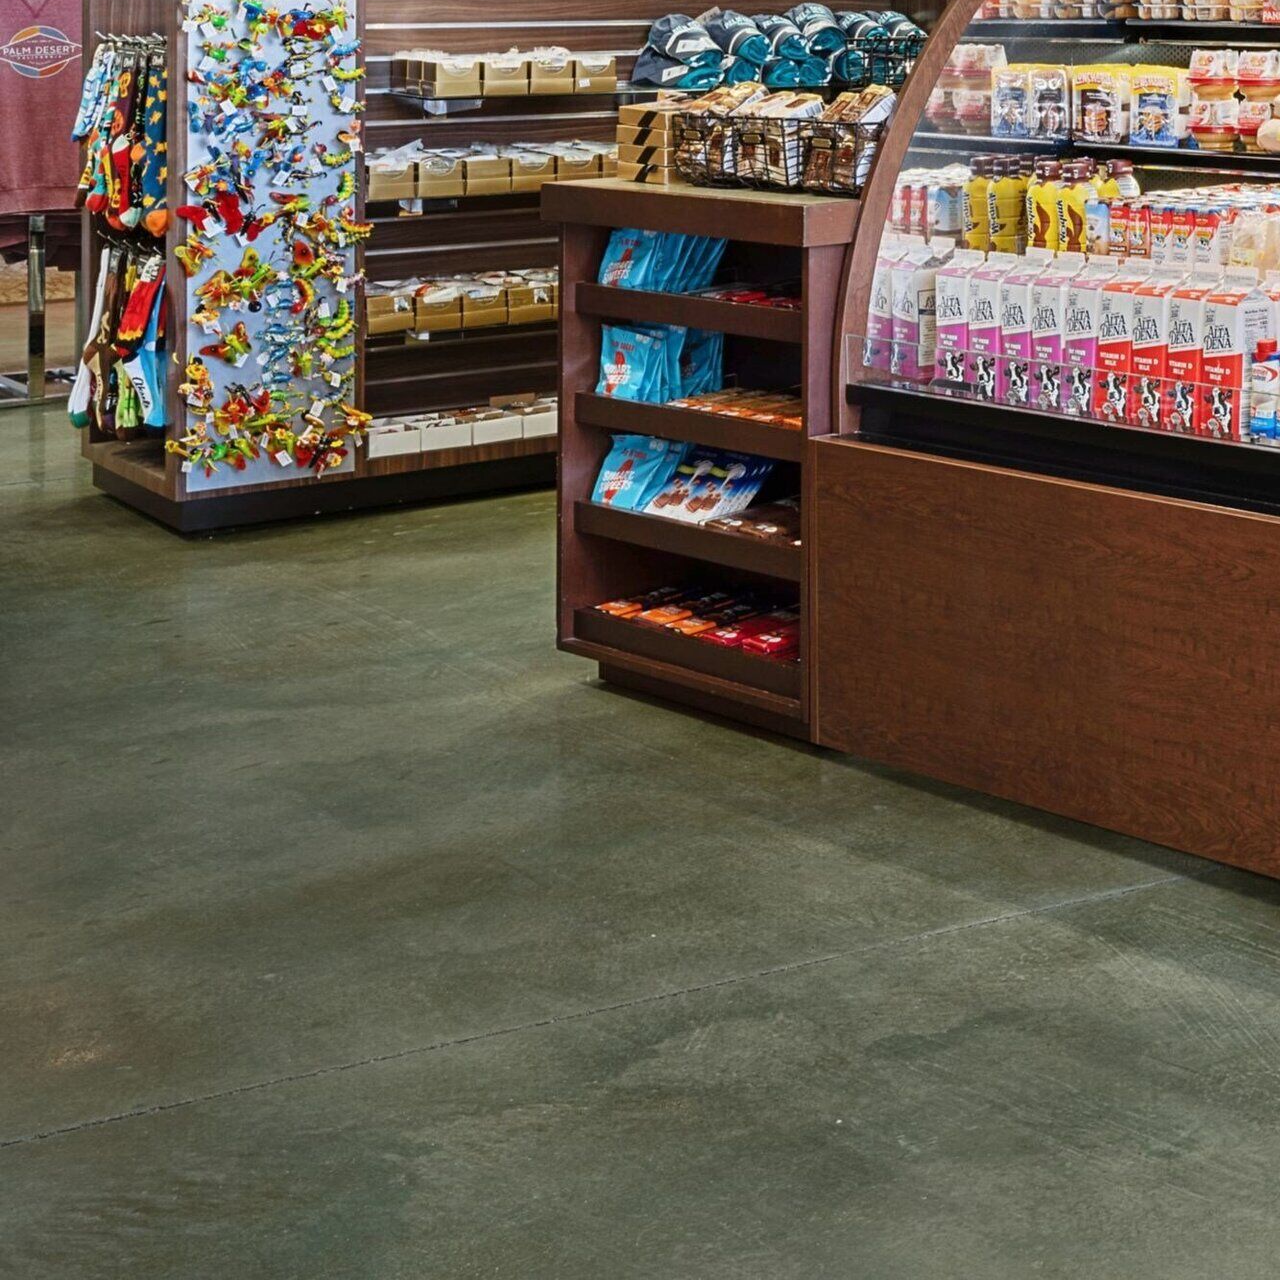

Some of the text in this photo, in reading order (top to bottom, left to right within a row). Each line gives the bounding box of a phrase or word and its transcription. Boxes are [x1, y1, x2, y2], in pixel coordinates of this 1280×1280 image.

[3, 46, 75, 55] PALM DESERT
[1105, 314, 1125, 326] ALTA
[1100, 323, 1127, 337] DENA
[1209, 325, 1230, 338] ALTA
[1204, 335, 1231, 350] DENA
[1205, 365, 1224, 373] VITAMIN
